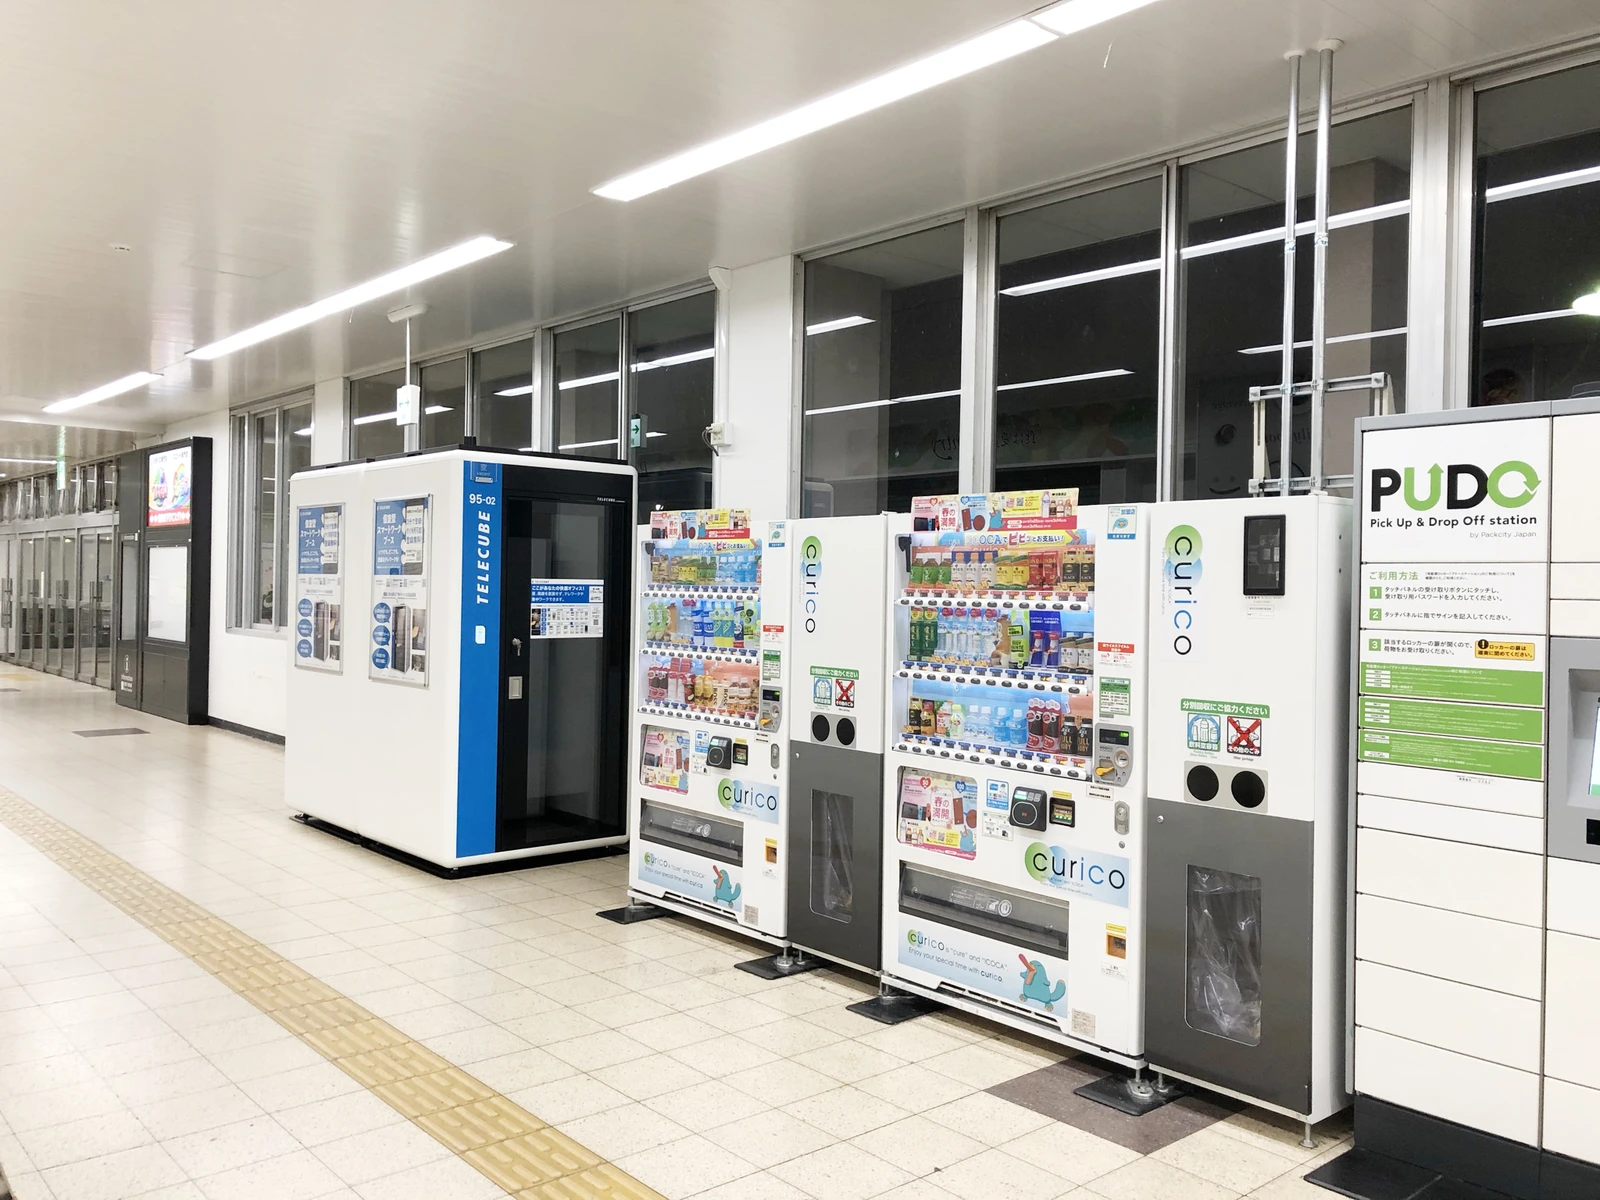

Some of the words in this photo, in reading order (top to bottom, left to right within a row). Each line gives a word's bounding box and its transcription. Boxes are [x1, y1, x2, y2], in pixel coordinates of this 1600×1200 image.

[1371, 460, 1542, 512] PUDO
[469, 494, 496, 506] 95-02
[1370, 518, 1392, 528] Pick
[1396, 518, 1412, 529] Up
[1417, 518, 1425, 527] &
[1428, 517, 1459, 528] Drop
[1463, 515, 1485, 526] Off
[1490, 515, 1537, 525] station
[476, 510, 490, 604] TELECUBE
[1369, 571, 1419, 581] ご利用方法
[805, 544, 819, 633] curico
[1174, 536, 1197, 655] curico
[1384, 612, 1512, 620] タッチパネルに指でサインを記入してください。
[1384, 639, 1473, 648] 該当するロッカーの扉が開くので、
[1384, 647, 1456, 655] 荷物をお受け取りください。
[1182, 701, 1268, 715] 分別回収にご協力ください
[1228, 746, 1260, 755] その他のごみ
[722, 786, 777, 810] curico
[934, 796, 950, 807] 春の
[1033, 852, 1125, 890] curico
[910, 932, 944, 951] curico
[909, 947, 922, 957] Enjoy
[922, 952, 935, 962] your
[935, 955, 954, 967] special
[955, 961, 967, 971] time
[969, 965, 980, 975] with
